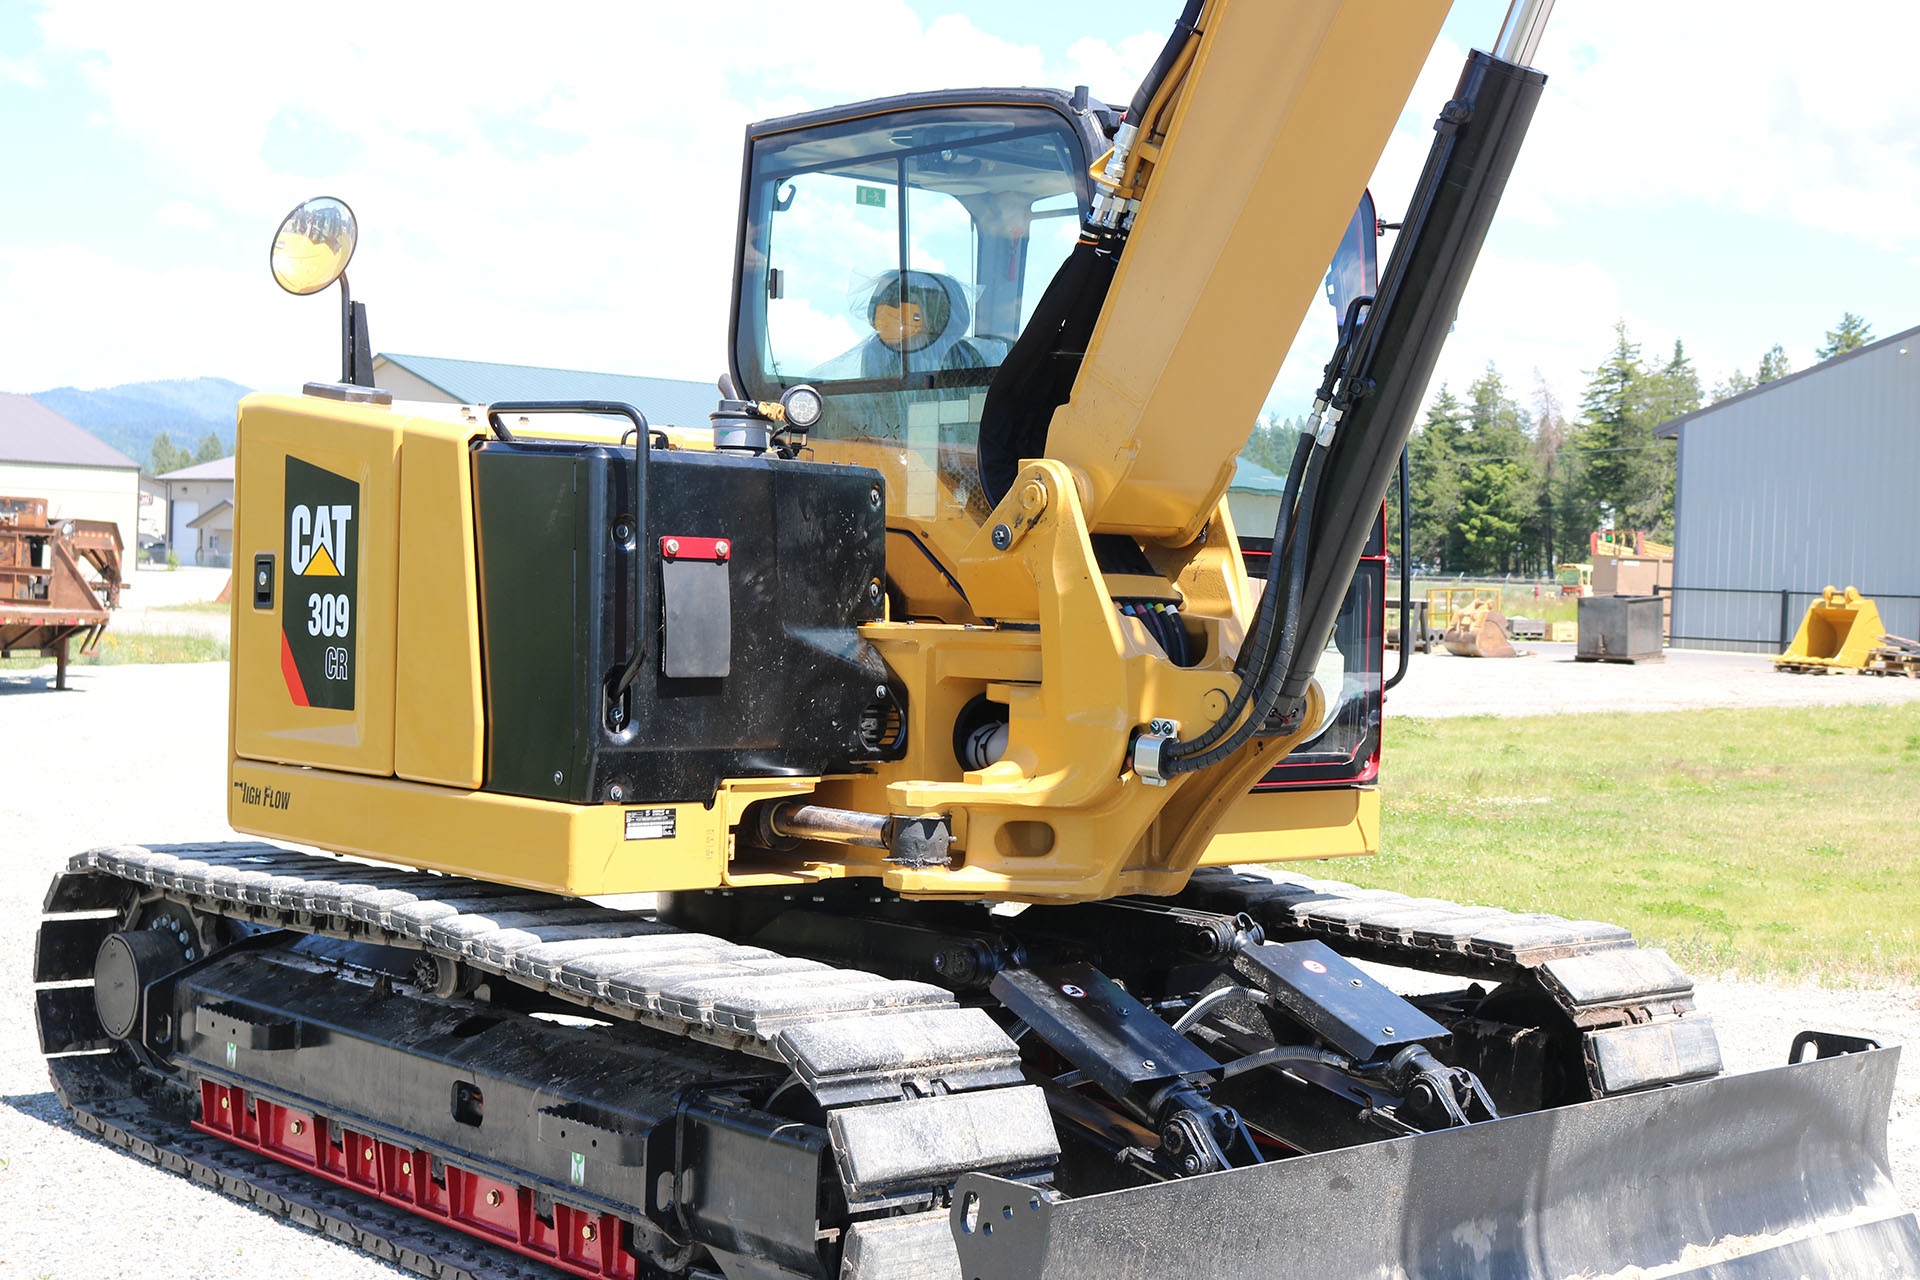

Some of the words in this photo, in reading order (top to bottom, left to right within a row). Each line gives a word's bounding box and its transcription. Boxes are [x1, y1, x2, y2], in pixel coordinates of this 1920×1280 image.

[290, 504, 352, 577] CAT
[307, 592, 350, 638] 309
[324, 646, 348, 681] CR
[263, 785, 291, 810] FLOW
